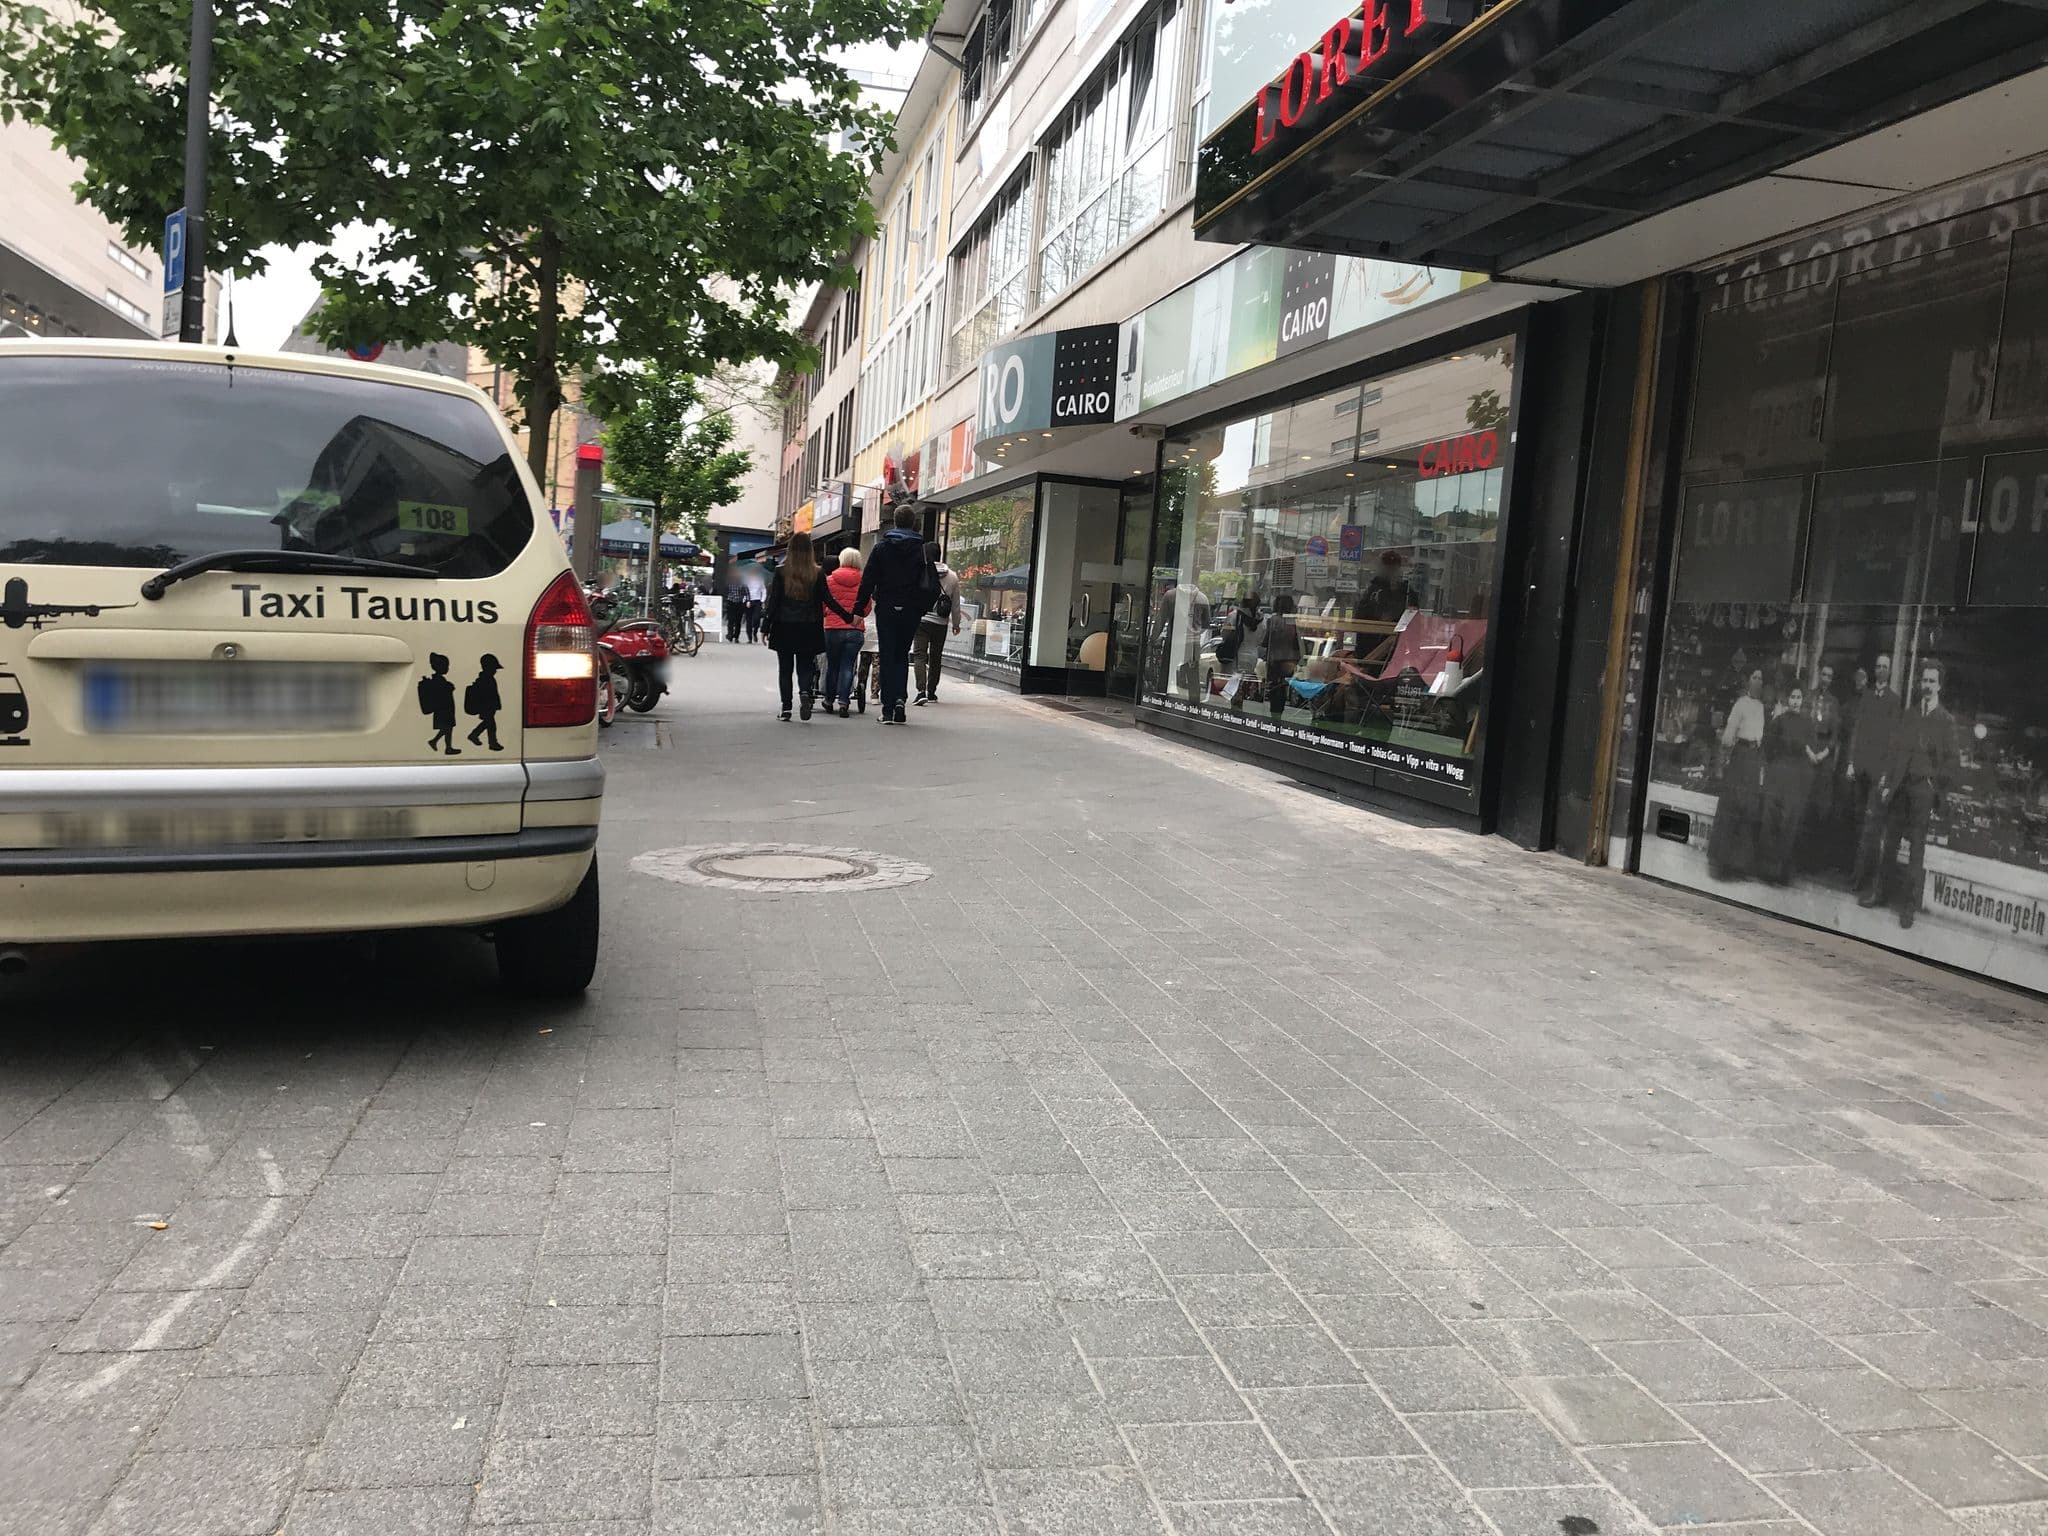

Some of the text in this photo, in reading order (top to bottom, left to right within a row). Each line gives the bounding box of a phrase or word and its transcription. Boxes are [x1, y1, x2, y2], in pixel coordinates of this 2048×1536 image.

[168, 222, 181, 282] P
[1282, 297, 1328, 342] CAIRO
[1055, 391, 1110, 417] CAIRO
[1418, 430, 1498, 478] CAIRO
[411, 507, 457, 532] 108
[231, 584, 499, 624] Taxi Taunus
[1349, 741, 1366, 755] Thonet
[1371, 746, 1387, 760] Tobias
[1387, 750, 1401, 762] Grau
[1406, 753, 1419, 769] Vipp
[1425, 758, 1440, 772] vitra
[1446, 763, 1464, 781] Wogg
[1933, 874, 2046, 936] Wäschemangeln
